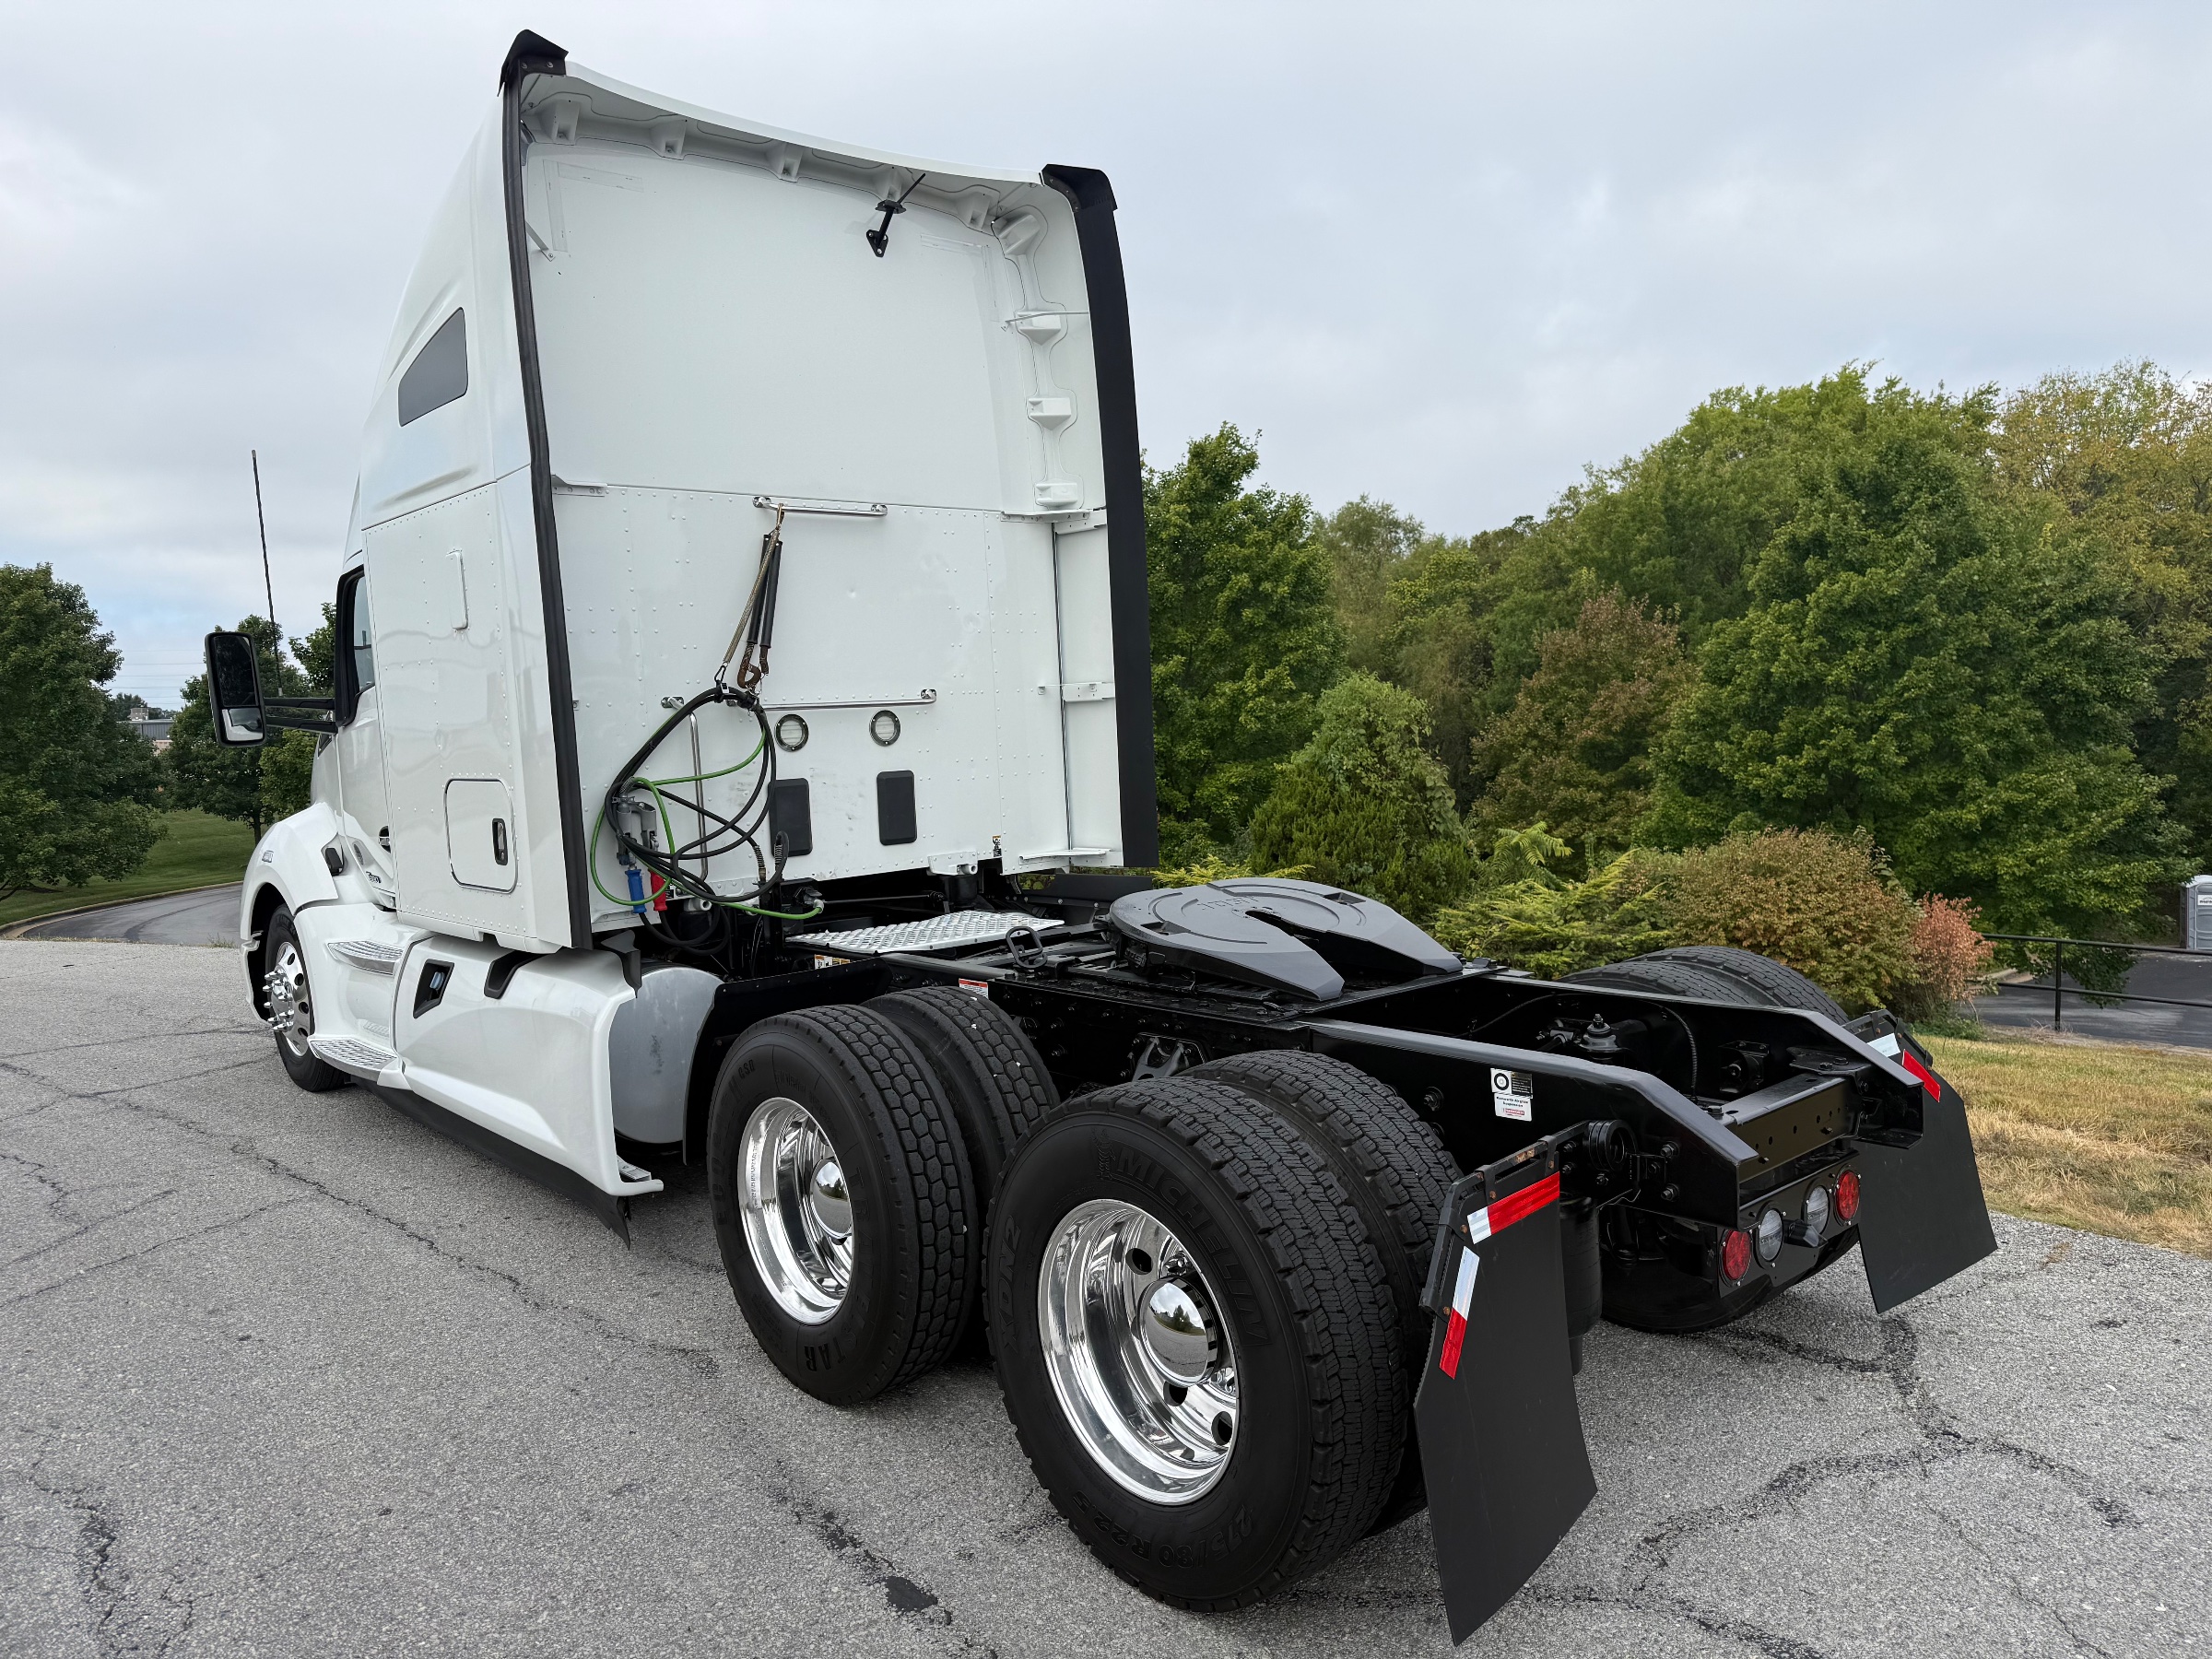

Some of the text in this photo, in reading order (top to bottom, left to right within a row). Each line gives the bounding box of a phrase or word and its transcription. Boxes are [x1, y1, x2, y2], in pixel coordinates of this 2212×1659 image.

[998, 1215, 1021, 1353] XDN2
[1116, 1147, 1268, 1341] MICHELIN
[1159, 1504, 1254, 1568] 275/80
